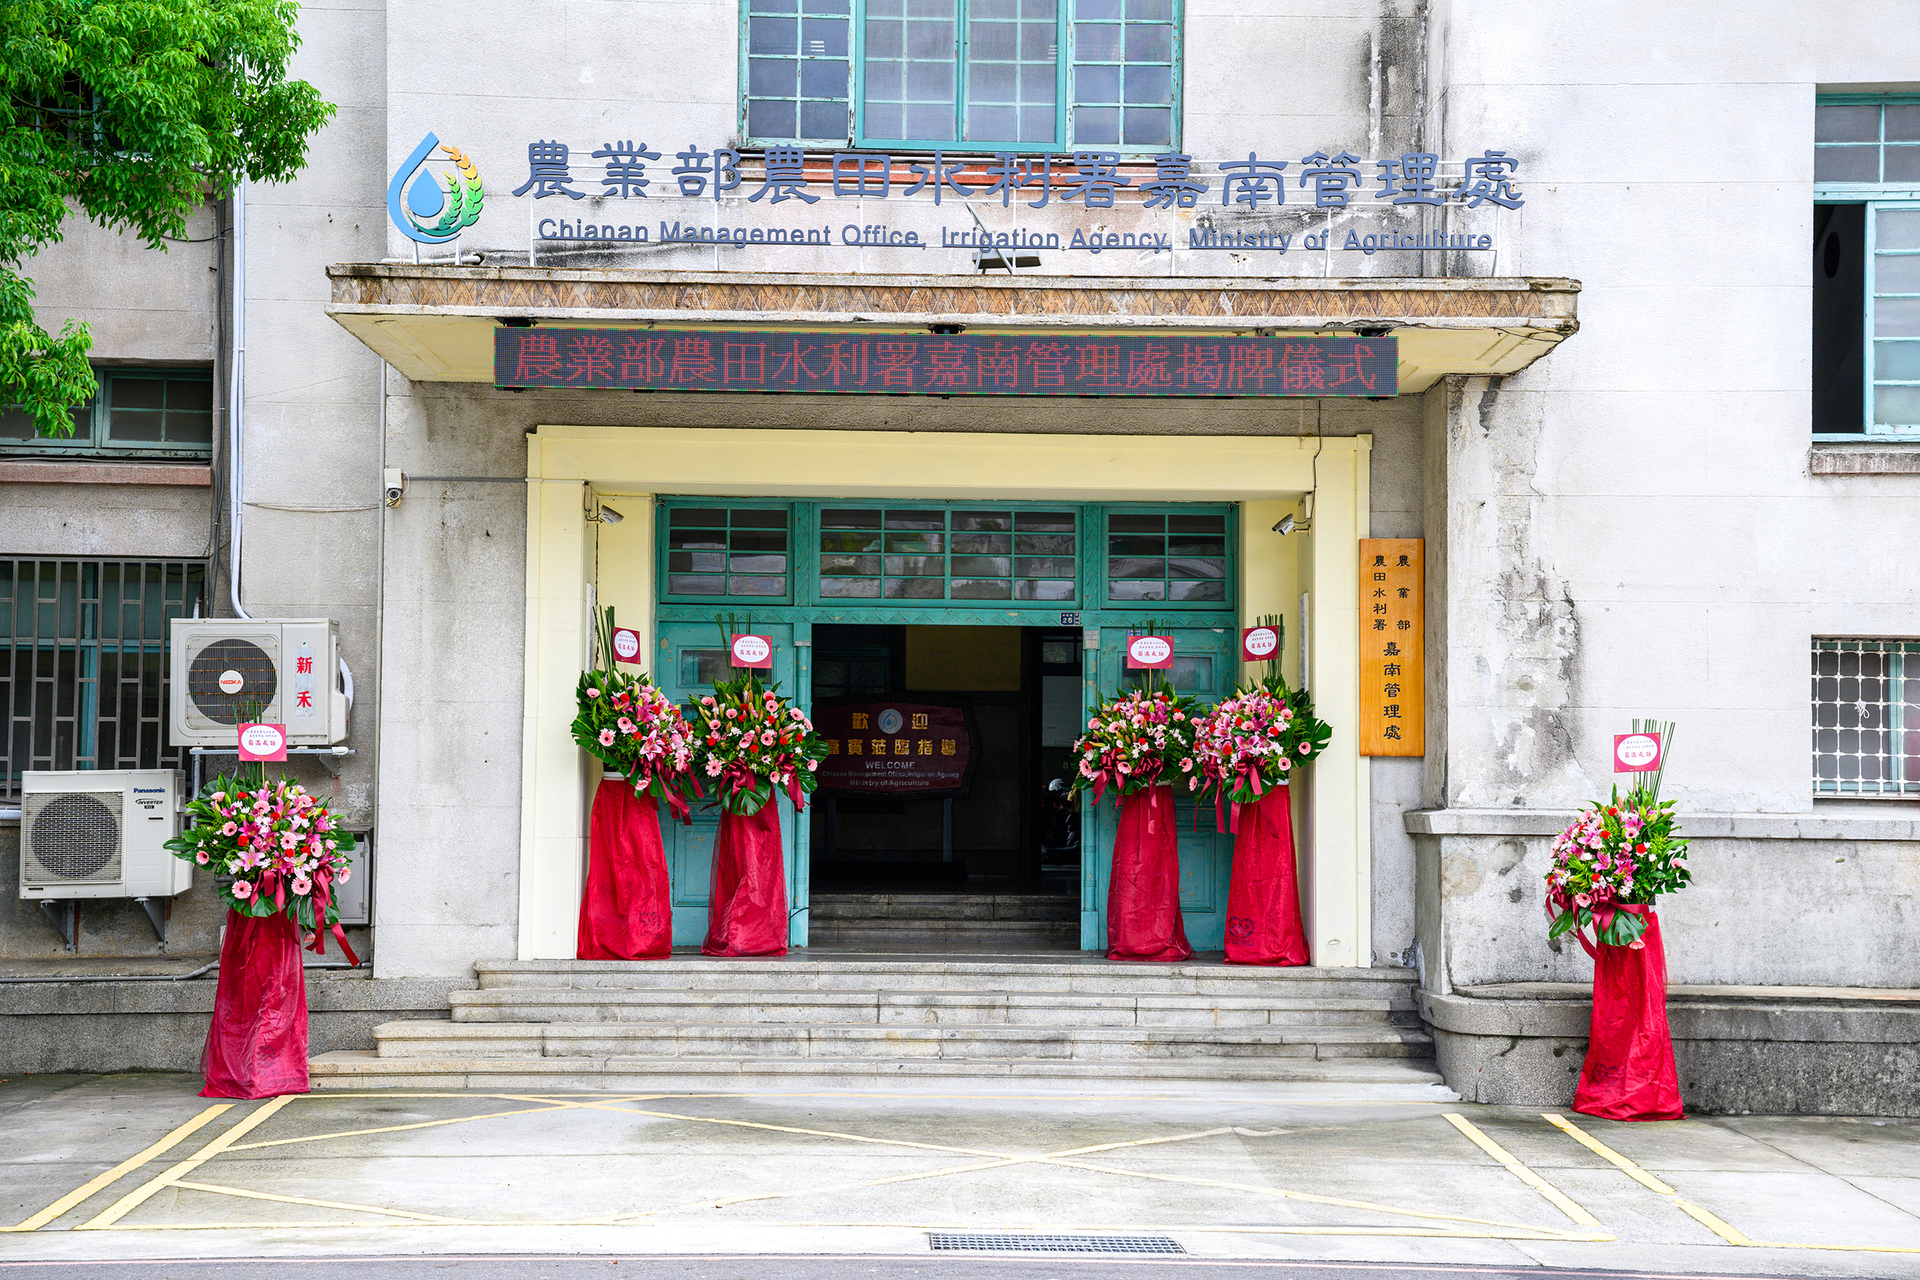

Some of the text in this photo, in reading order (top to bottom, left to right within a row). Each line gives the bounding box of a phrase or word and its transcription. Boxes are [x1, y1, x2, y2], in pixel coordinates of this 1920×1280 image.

[511, 139, 1525, 211] 農業部農田水利署嘉南管理處
[538, 218, 1493, 256] Chianan Management Office, Irrigation Agency, Ministry of Agriculture
[513, 333, 1377, 390] 農業部農田水利署嘉南管理處揭牌儀式
[1372, 554, 1388, 632] 農田水利署
[1396, 554, 1411, 631] 農業部
[296, 656, 313, 709] 新禾
[1383, 641, 1402, 741] 嘉南管理處
[850, 779, 879, 787] Ministry
[889, 779, 930, 788] Agriculture
[865, 761, 915, 769] WELCOME
